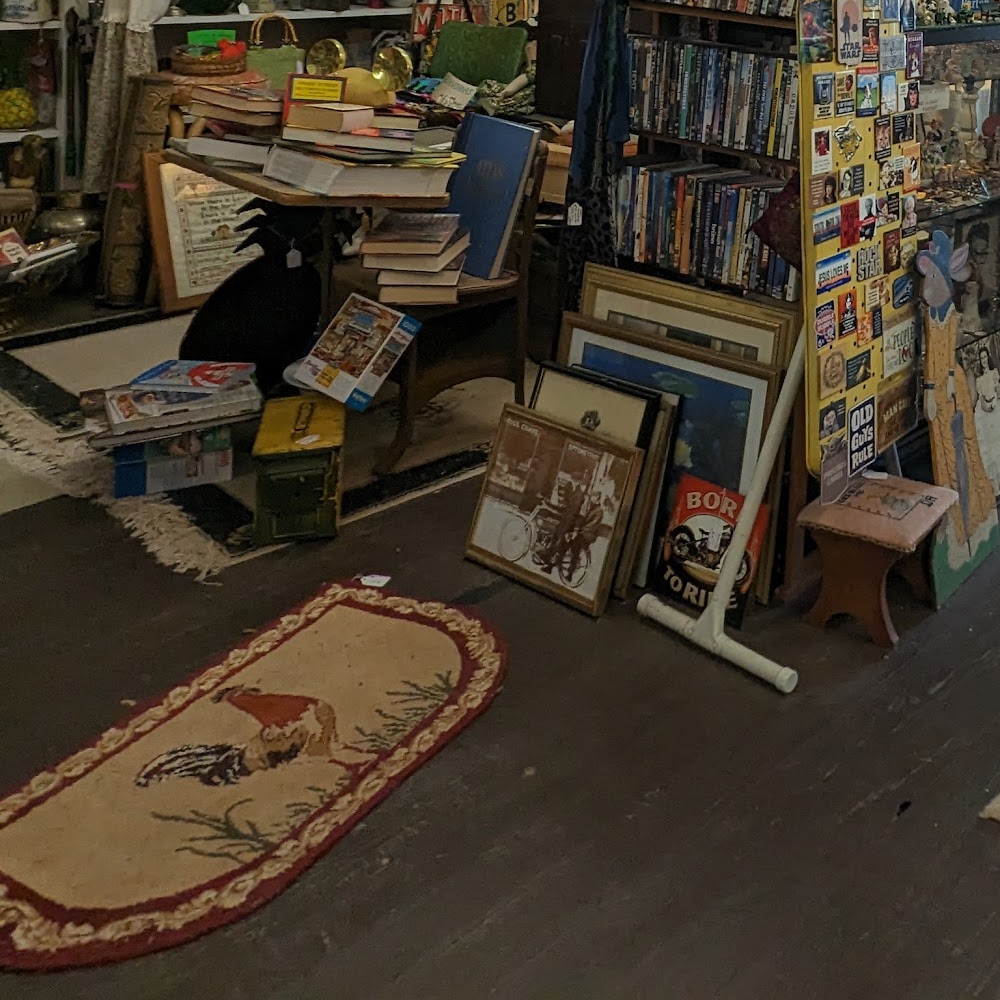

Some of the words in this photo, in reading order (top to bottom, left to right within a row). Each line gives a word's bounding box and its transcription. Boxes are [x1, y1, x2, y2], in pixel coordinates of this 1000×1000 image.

[840, 42, 861, 51] STAR
[840, 50, 862, 59] WARS
[851, 403, 874, 432] OLD
[851, 444, 874, 470] RULE
[686, 491, 738, 518] BOR
[663, 566, 683, 592] TO
[683, 583, 738, 609] RIE
